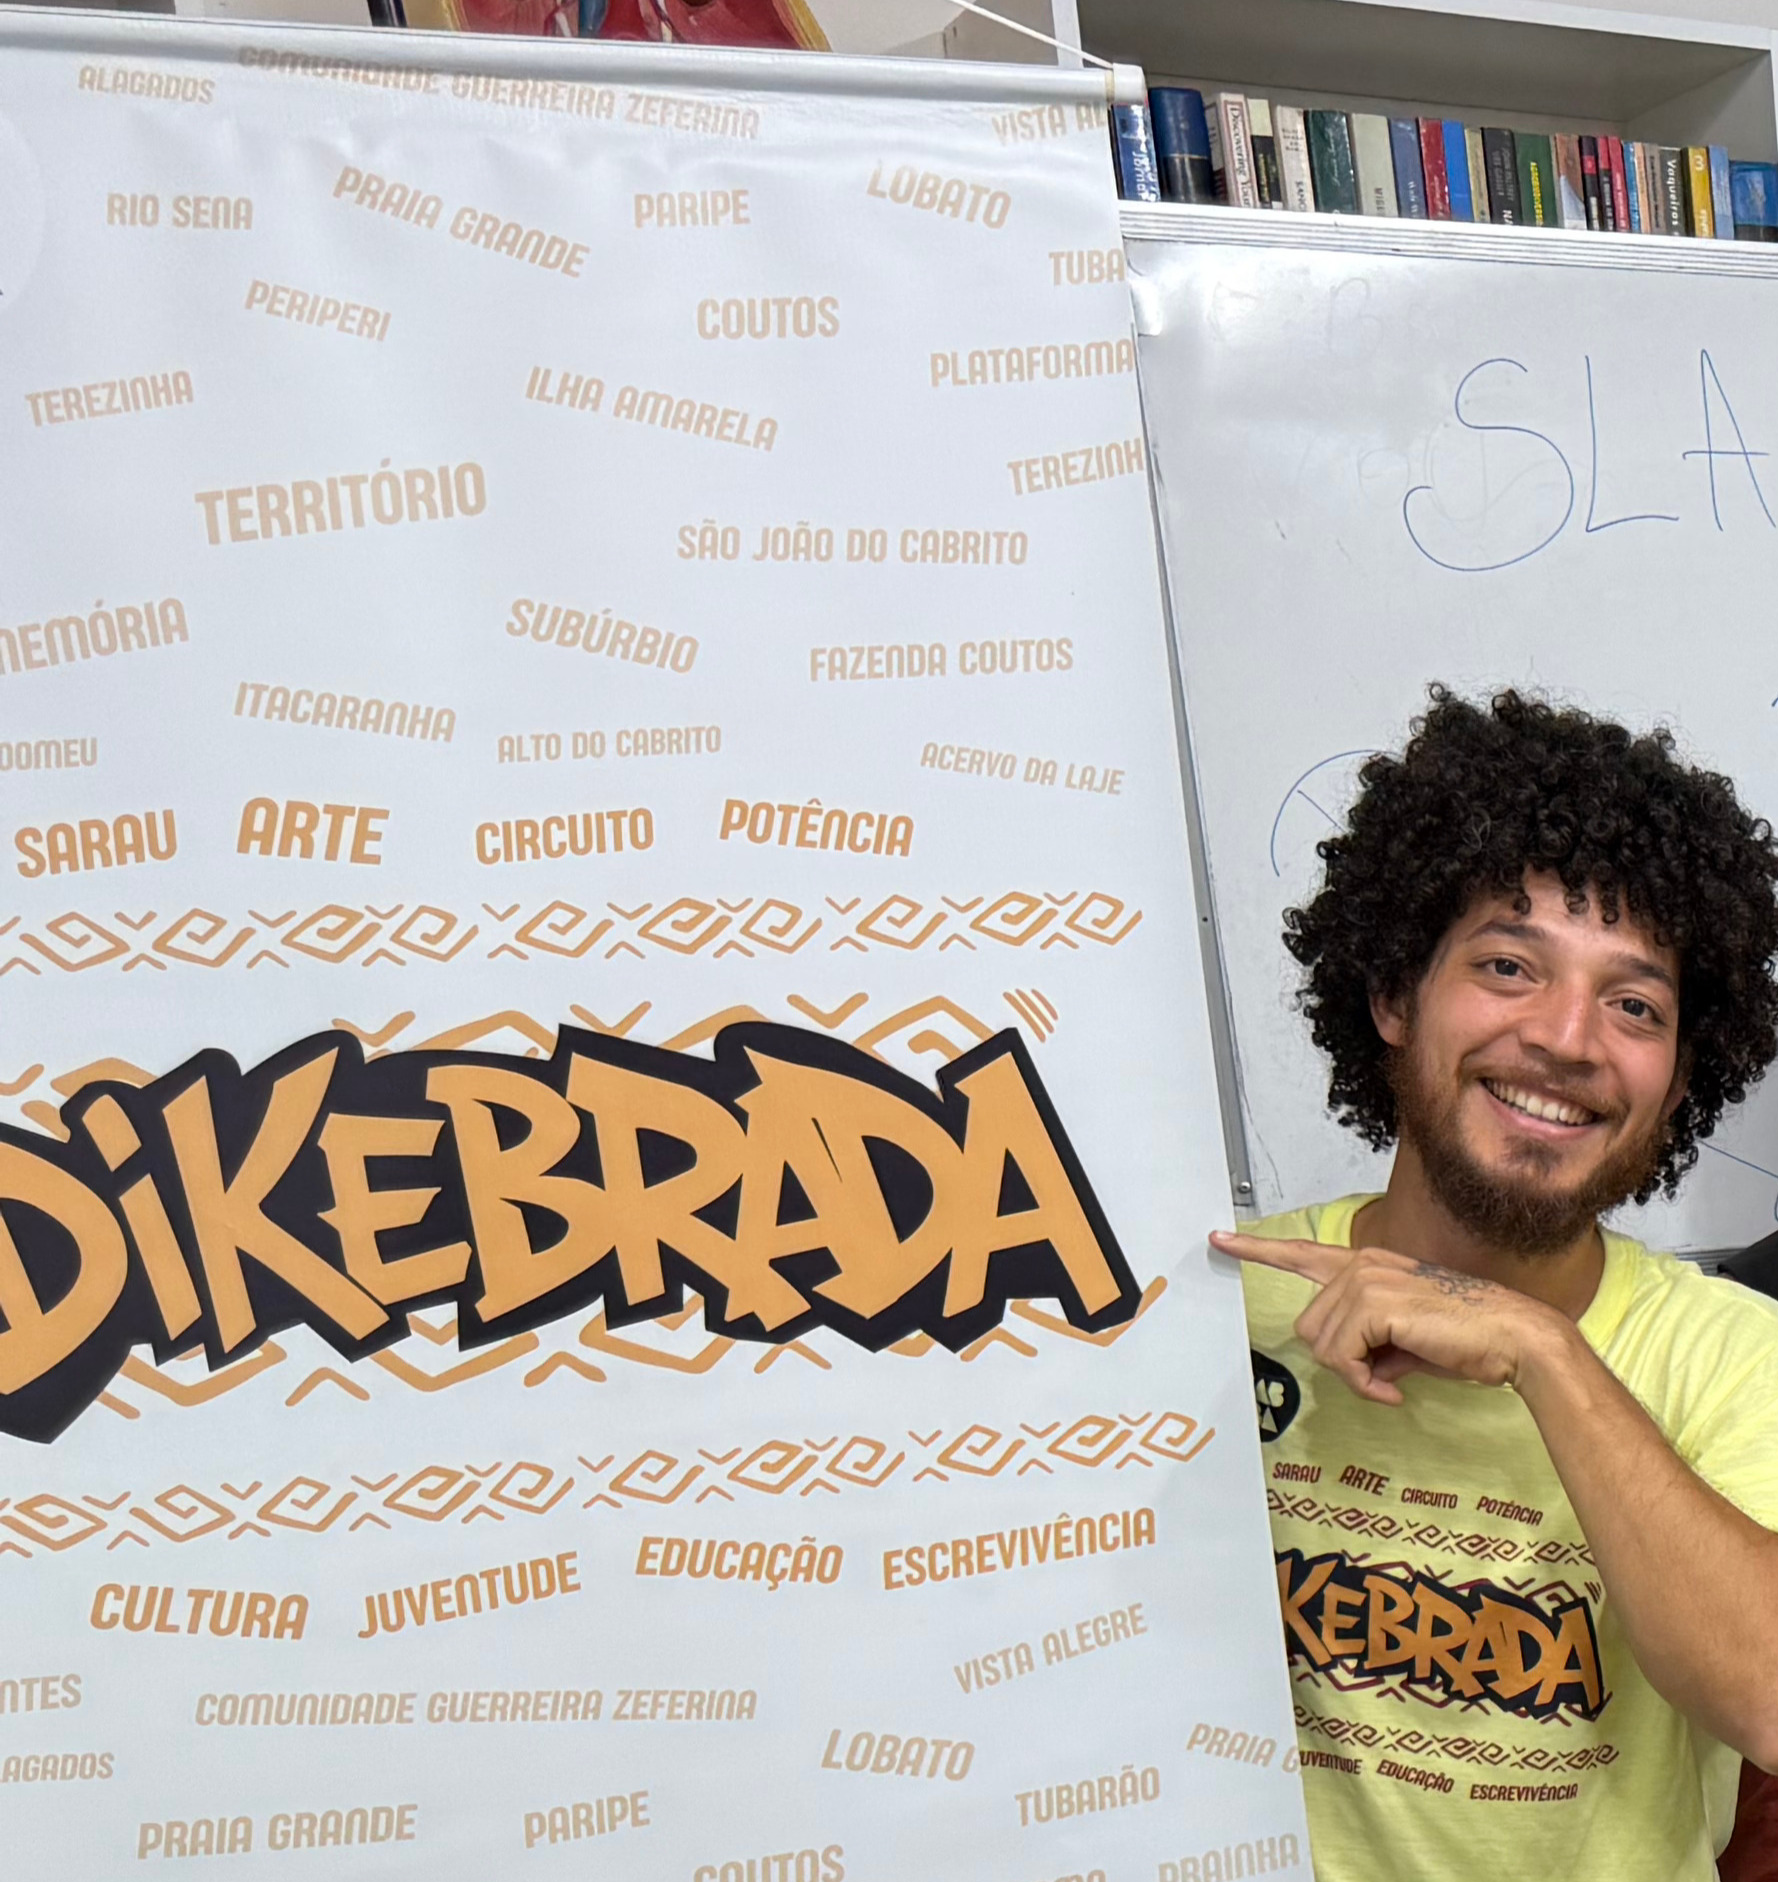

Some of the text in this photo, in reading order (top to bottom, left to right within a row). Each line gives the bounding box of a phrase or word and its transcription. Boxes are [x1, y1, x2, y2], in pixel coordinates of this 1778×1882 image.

[78, 64, 216, 104] ALAGADOS
[238, 46, 760, 140] COMUNIDADE GUERREIRA ZEFERINA
[992, 103, 1066, 147] VISTA
[1228, 104, 1248, 177] Discovering
[106, 192, 254, 230] RIO SENA
[634, 188, 751, 229] PARIPE
[866, 158, 1012, 230] LOBATO
[1666, 159, 1679, 226] Vaqueiros
[332, 165, 591, 279] PRAIA GRANDE
[244, 279, 391, 342] PERIPERI
[697, 296, 840, 340] COUTOS
[930, 337, 1137, 388] PLATAFORMA
[25, 370, 194, 427] TEREZINHA
[526, 365, 779, 451] ILHA AMARELA
[194, 457, 487, 545] TERRITÓRIO
[676, 519, 1028, 566] SÃO JOÃO DO CABRITO
[505, 596, 699, 675] SUBÚRBIO
[810, 637, 1073, 683] FAZENDA COUTOS
[233, 680, 456, 744] ITACARANHA
[498, 725, 722, 764] ALTO DO CABRITO
[920, 740, 1125, 796] ACERVO DA LAJE
[13, 795, 915, 879] SARAU ARTE CIRCUITO POTÊNCIA
[1272, 1461, 1544, 1526] SARAU ARTE CIRCUITO POTÊNCIA
[90, 1507, 1156, 1640] CULTURA JUVENTUDE EDUCAÇÃO ESCREVIVÊNCIA
[953, 1602, 1148, 1694] VISTA ALEGRE
[195, 1688, 757, 1726] COMUNIDADE GUERREIRA ZEFERINA
[821, 1729, 974, 1782] LOBATO
[1186, 1722, 1276, 1768] PRAIA
[1015, 1764, 1160, 1827] TUBARÃO
[1377, 1759, 1454, 1794] EDUCAÇÃO
[1470, 1783, 1578, 1801] ESCREVIVÊNCIA
[137, 1804, 418, 1859] PRAIA GRANDE
[523, 1790, 650, 1848] PARIPE
